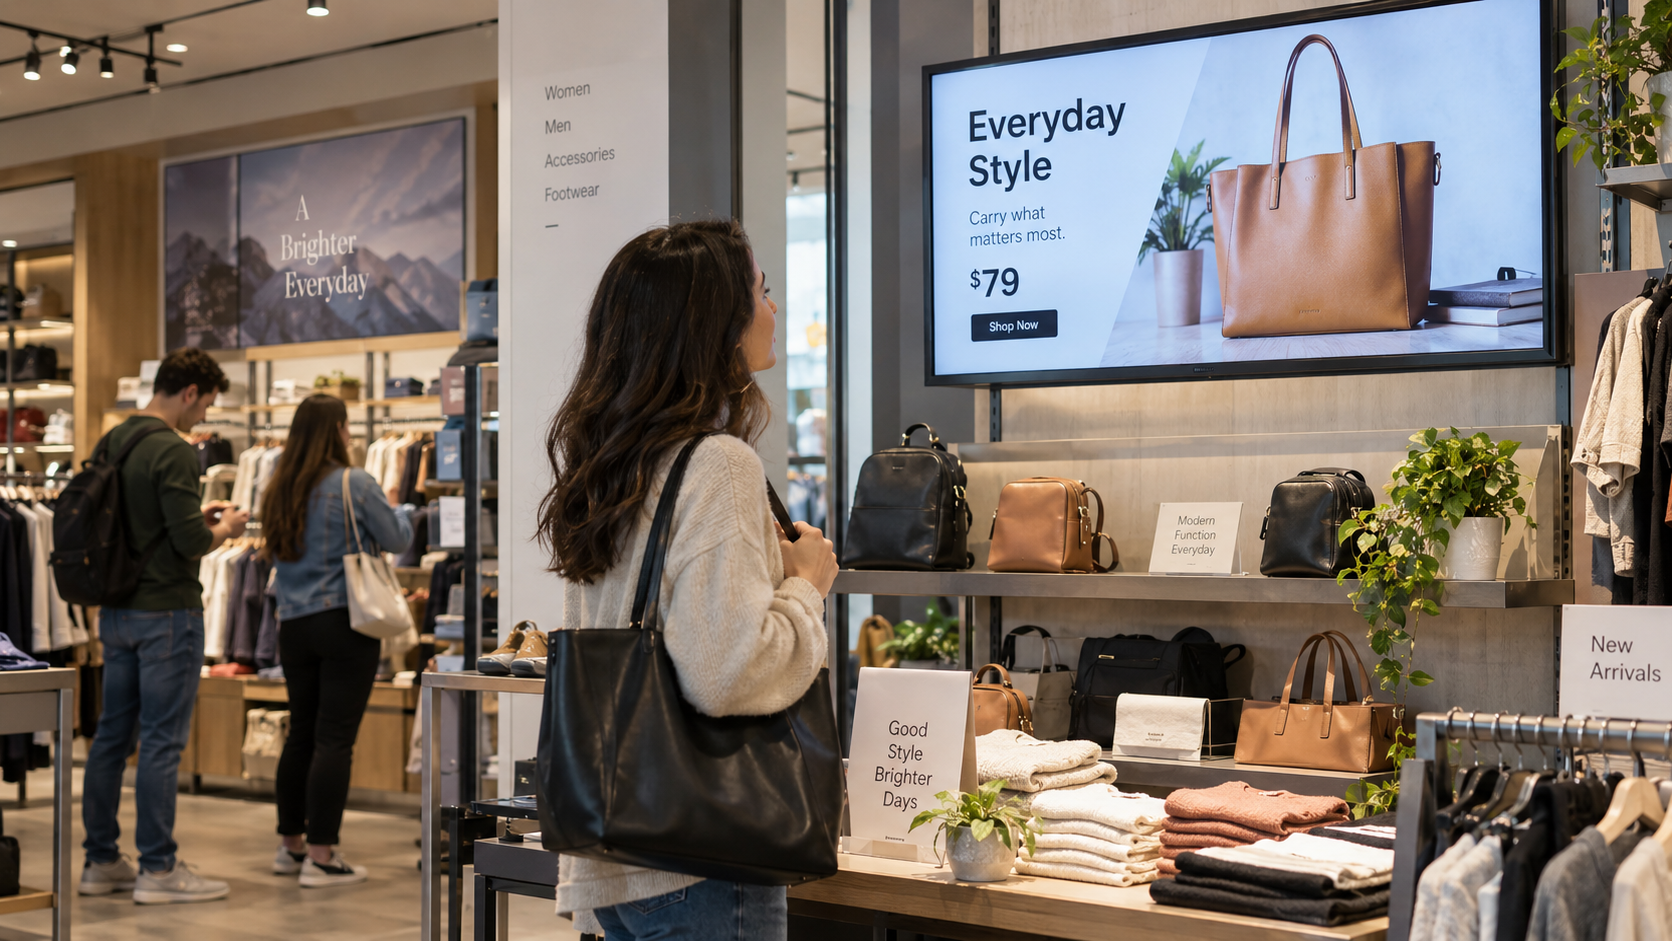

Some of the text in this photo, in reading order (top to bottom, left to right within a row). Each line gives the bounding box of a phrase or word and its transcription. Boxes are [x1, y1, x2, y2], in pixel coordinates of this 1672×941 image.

[544, 84, 591, 101] Women
[545, 118, 572, 135] Men
[969, 97, 1127, 142] Everyday
[544, 147, 616, 169] Accessories
[969, 149, 1052, 192] Style
[545, 184, 600, 202] Footwear
[295, 194, 311, 222] A
[969, 205, 1046, 227] Carry what
[970, 226, 1066, 247] matters most.
[280, 229, 357, 266] Brighter
[284, 265, 370, 303] Everyday
[970, 267, 1020, 298] $79
[989, 319, 1039, 334] Shop Now
[1177, 515, 1216, 526] Modern
[1174, 529, 1217, 541] Function
[1171, 543, 1216, 557] Everyday
[1591, 635, 1634, 654] New
[1589, 661, 1662, 683] Arrivals
[888, 719, 929, 738] Good
[887, 743, 923, 764] Style
[874, 765, 933, 788] Brighter
[882, 790, 918, 812] Days
